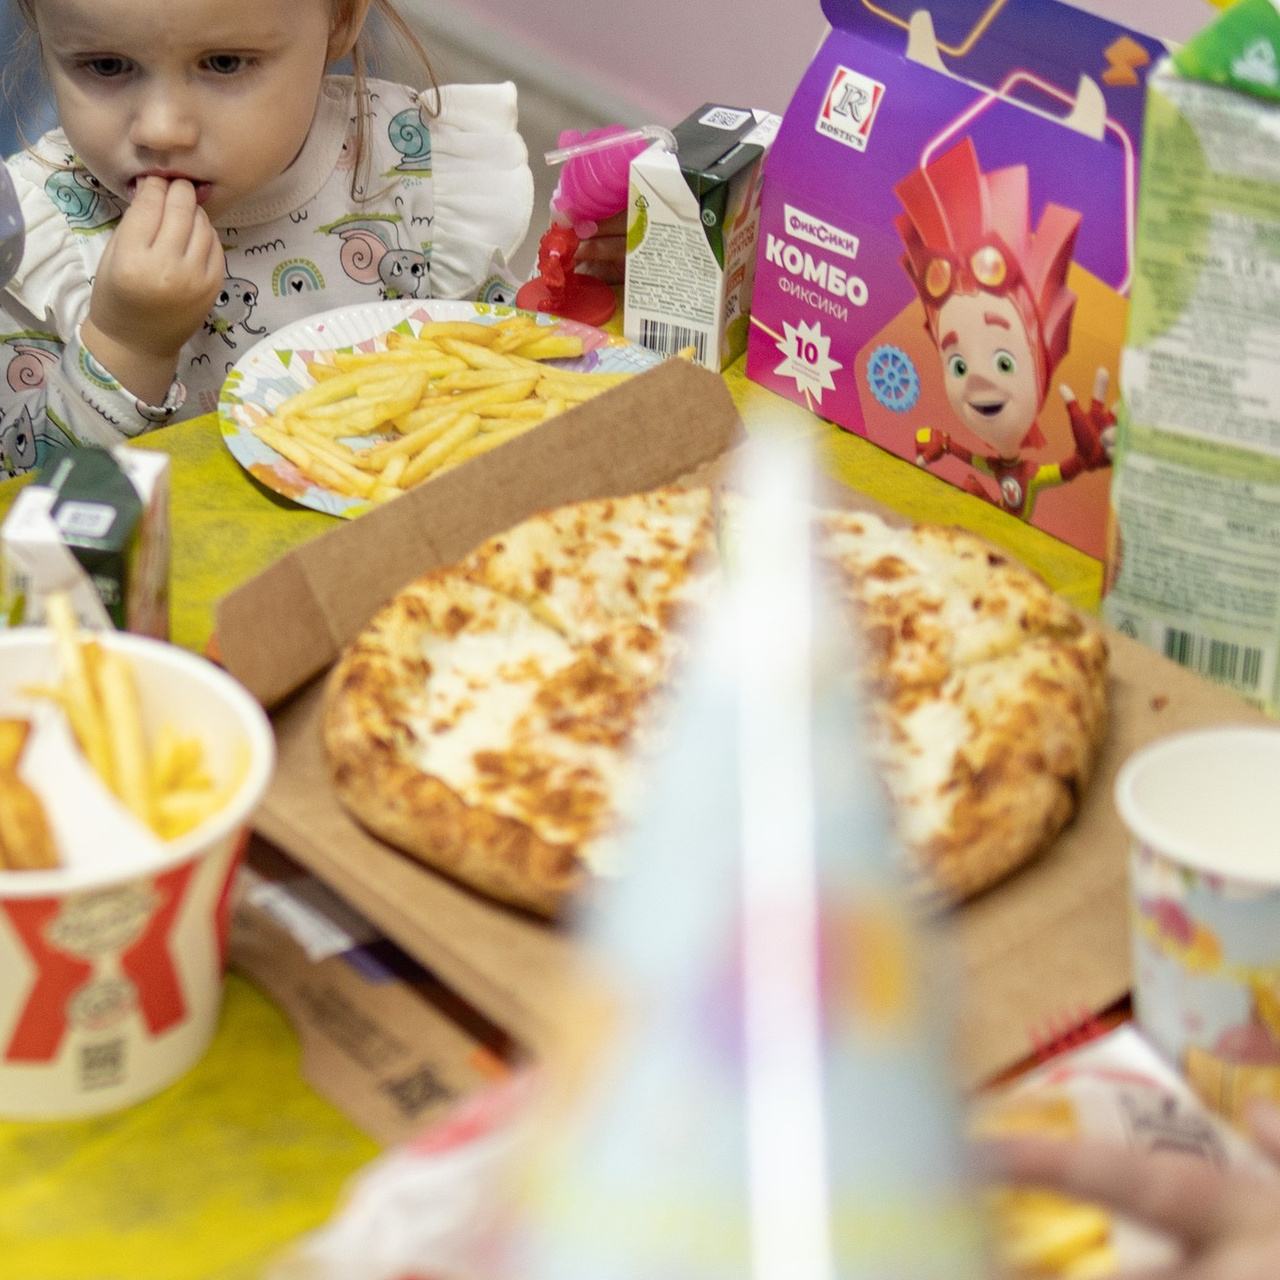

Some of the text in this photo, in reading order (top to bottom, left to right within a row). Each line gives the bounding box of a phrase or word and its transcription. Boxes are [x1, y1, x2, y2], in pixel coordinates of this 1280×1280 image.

[820, 121, 864, 147] ROSTIC'S
[765, 232, 870, 308] КОМБО
[777, 276, 849, 323] ФИКСИКИ
[795, 334, 819, 366] 10
